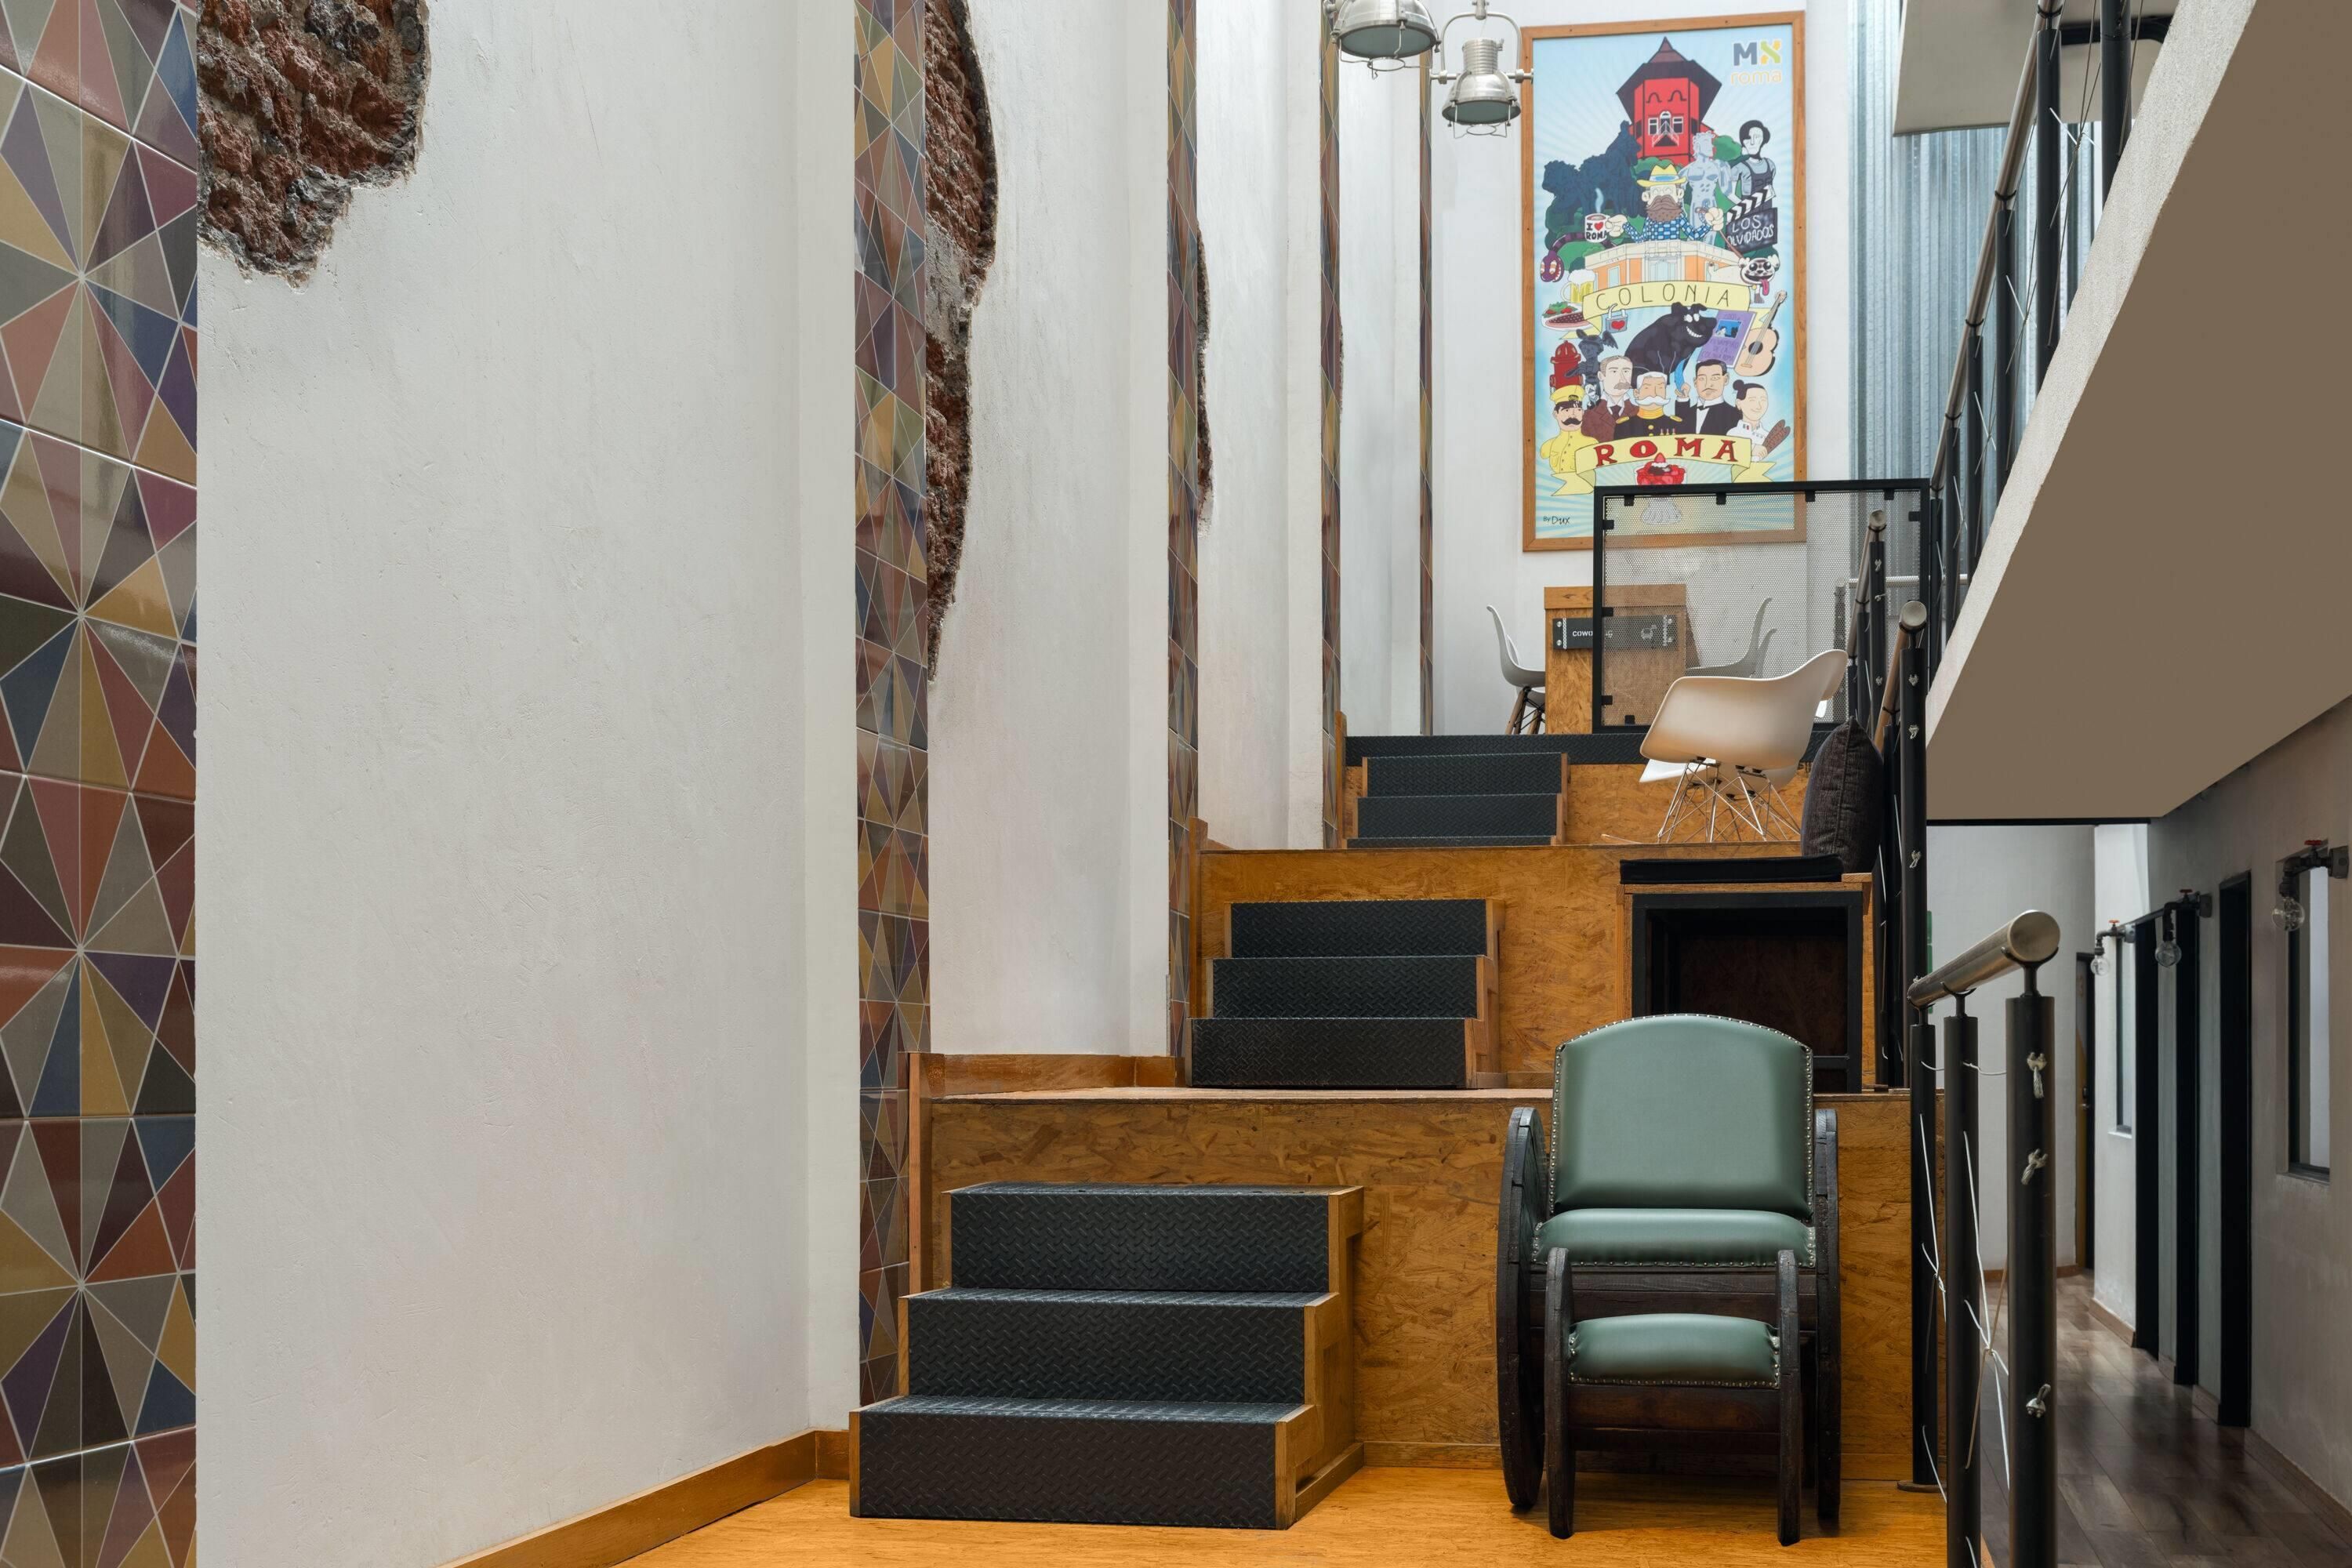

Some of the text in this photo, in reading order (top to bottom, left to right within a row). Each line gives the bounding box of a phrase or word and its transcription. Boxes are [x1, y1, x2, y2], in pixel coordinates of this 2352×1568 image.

[1733, 40, 1781, 66] MX
[1730, 71, 1782, 85] roma
[1732, 214, 1762, 233] LOS
[1596, 283, 1730, 310] COLONIA
[1593, 437, 1738, 467] ROMA
[1552, 516, 1570, 525] Dux
